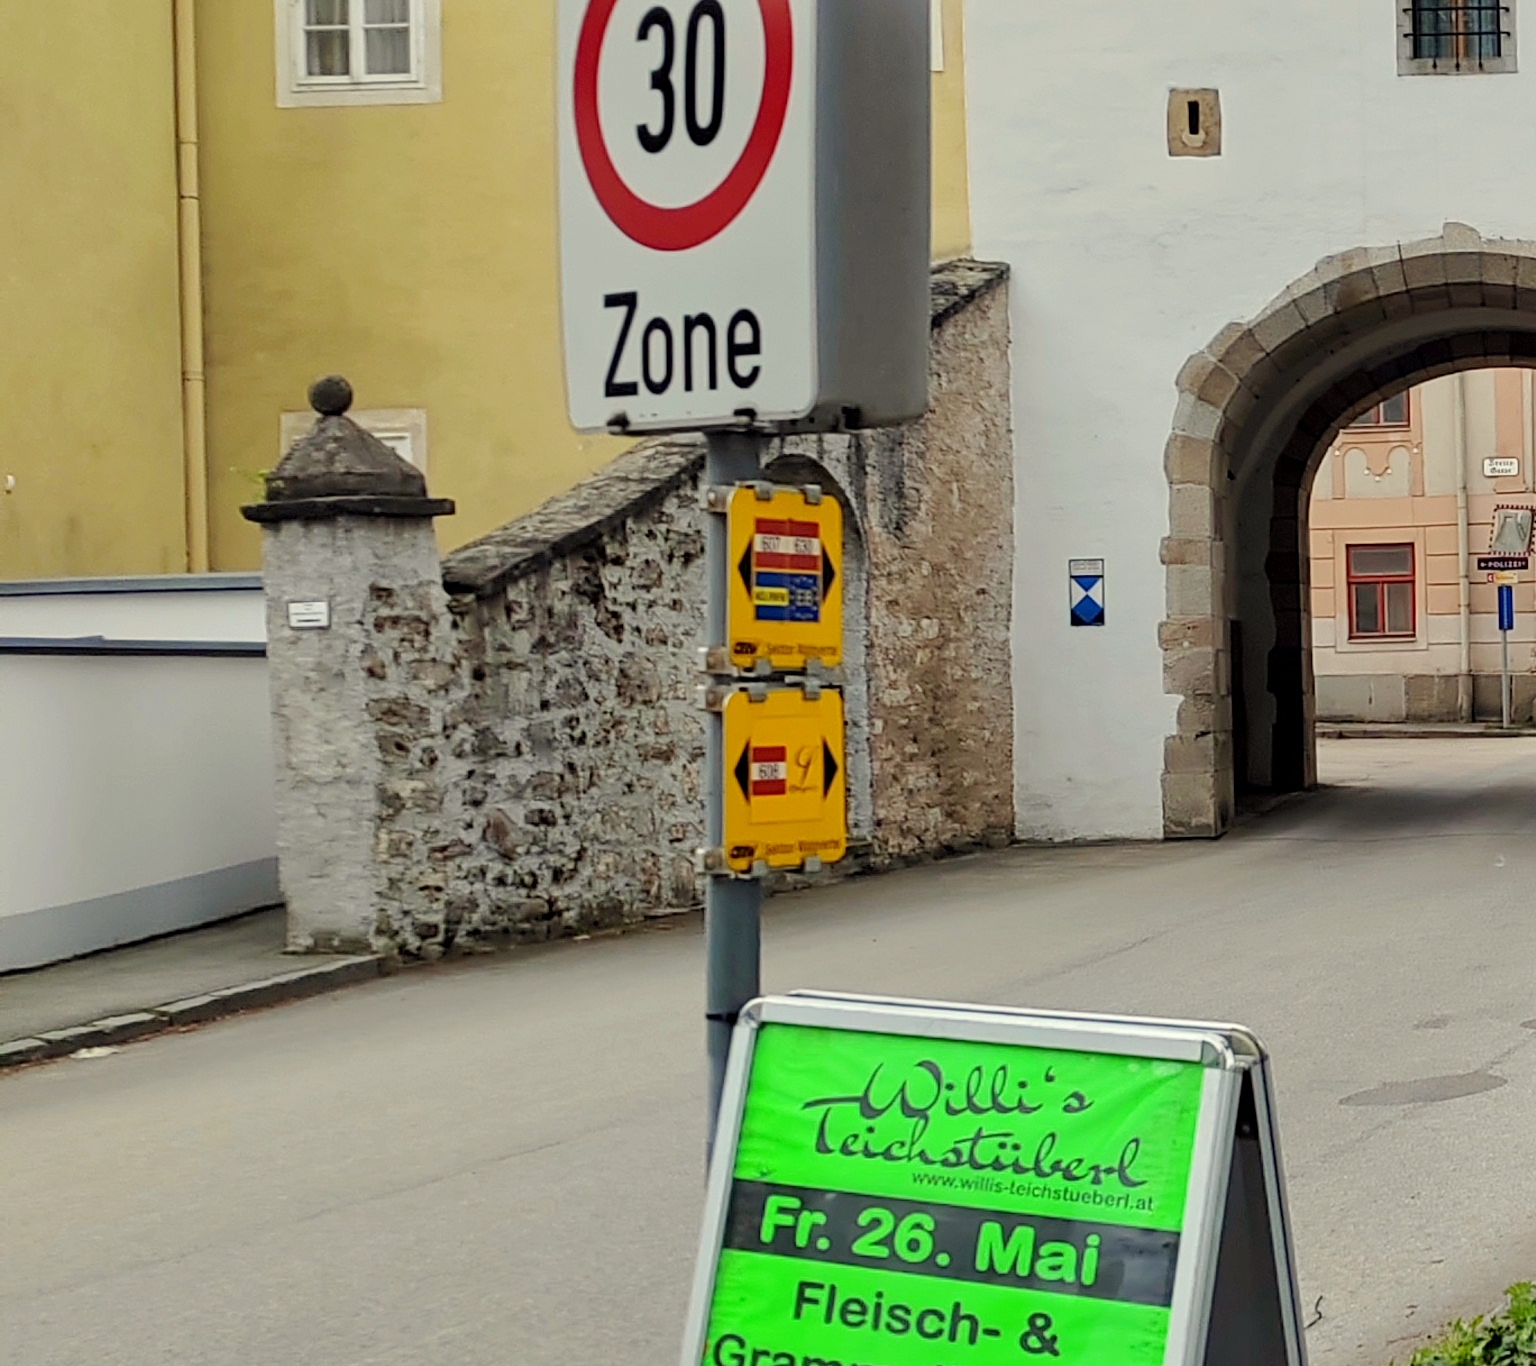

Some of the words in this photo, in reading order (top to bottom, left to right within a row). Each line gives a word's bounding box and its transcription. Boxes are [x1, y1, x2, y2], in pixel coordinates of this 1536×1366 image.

[604, 291, 761, 397] Zone
[801, 1096, 1148, 1188] Teichstüberl
[912, 1170, 1153, 1212] www.willis-teichstueberl.at
[758, 1194, 830, 1251] Fr.
[851, 1207, 950, 1268] 26.
[975, 1221, 1101, 1287] Mai
[792, 1280, 1001, 1345] Fleisch-
[1019, 1312, 1060, 1357] &
